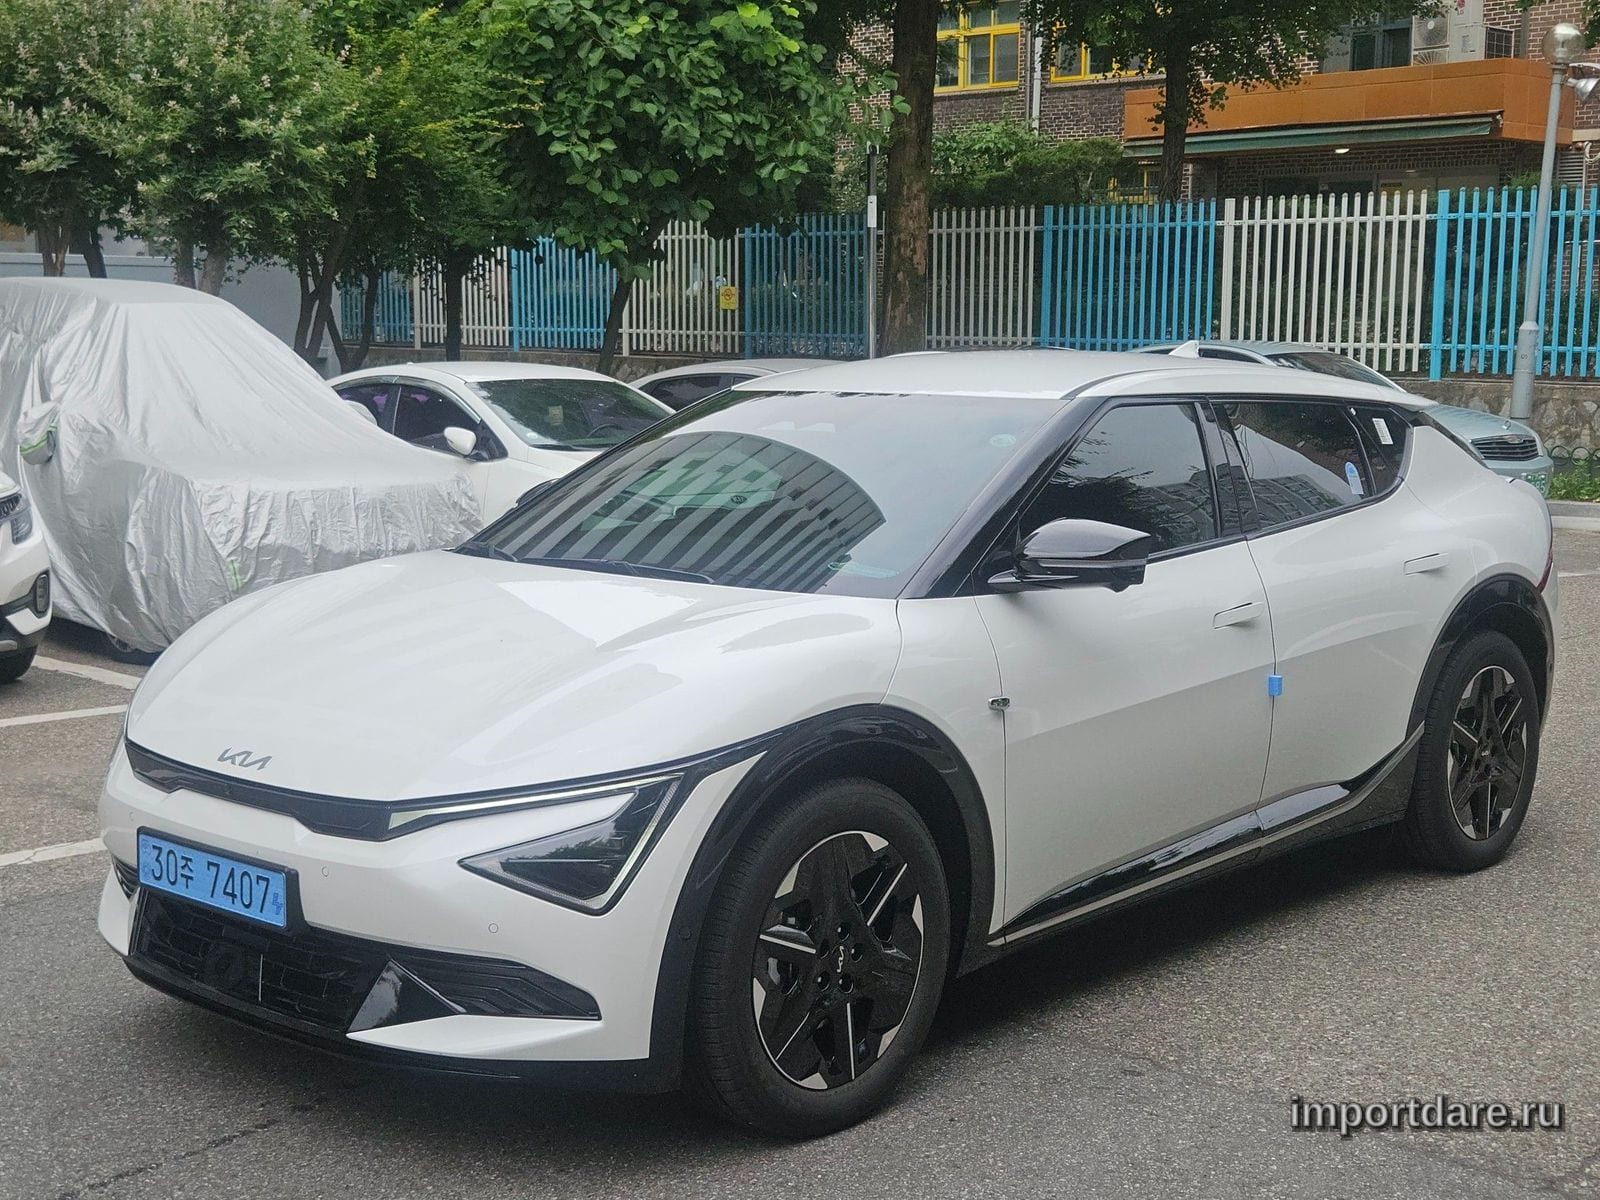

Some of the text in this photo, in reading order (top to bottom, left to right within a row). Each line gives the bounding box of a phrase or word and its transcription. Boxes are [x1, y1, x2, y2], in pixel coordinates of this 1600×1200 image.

[217, 747, 272, 770] KIA
[151, 844, 194, 889] 30주
[206, 859, 270, 914] 7407
